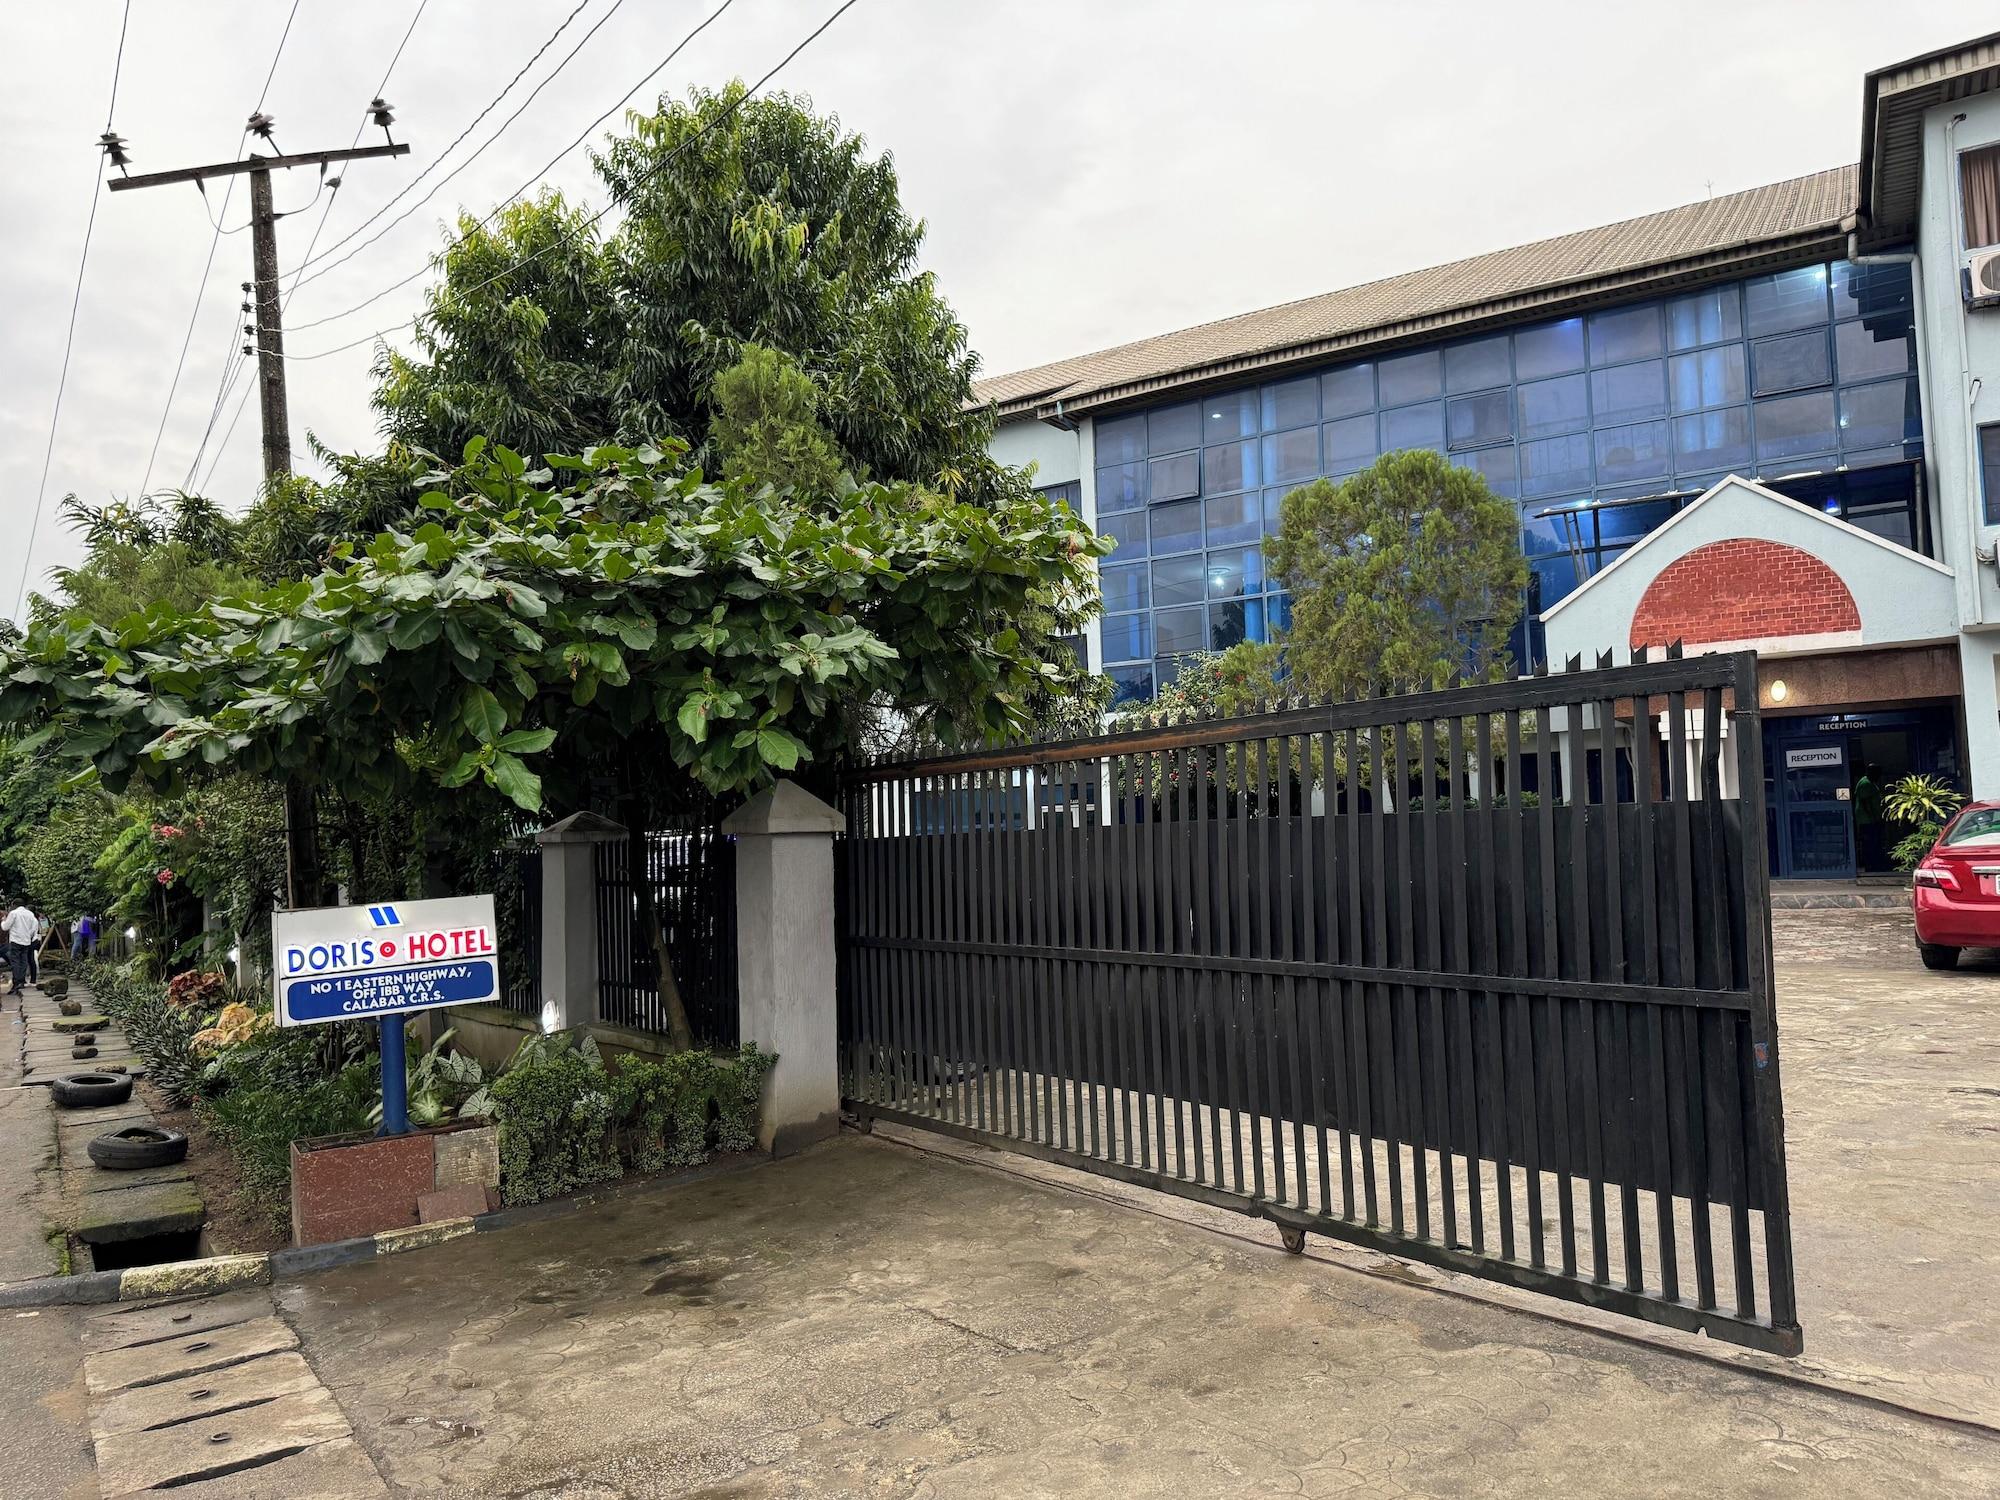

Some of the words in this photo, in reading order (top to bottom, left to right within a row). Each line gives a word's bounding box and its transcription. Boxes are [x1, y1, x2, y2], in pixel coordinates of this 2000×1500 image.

[1819, 721, 1866, 730] RECEPTION
[1791, 752, 1837, 762] RECEPTION
[287, 940, 375, 973] DORIS
[408, 928, 492, 960] HOTEL
[310, 982, 332, 995] NO
[335, 980, 342, 991] 1
[344, 973, 404, 991] EASTERN
[405, 966, 472, 984] HIGHWAY,
[352, 987, 377, 1000] OFF
[381, 985, 401, 997] IBB
[403, 980, 435, 994] WAY
[342, 995, 406, 1012] CALABAR
[409, 990, 445, 1004] C.R.S.
